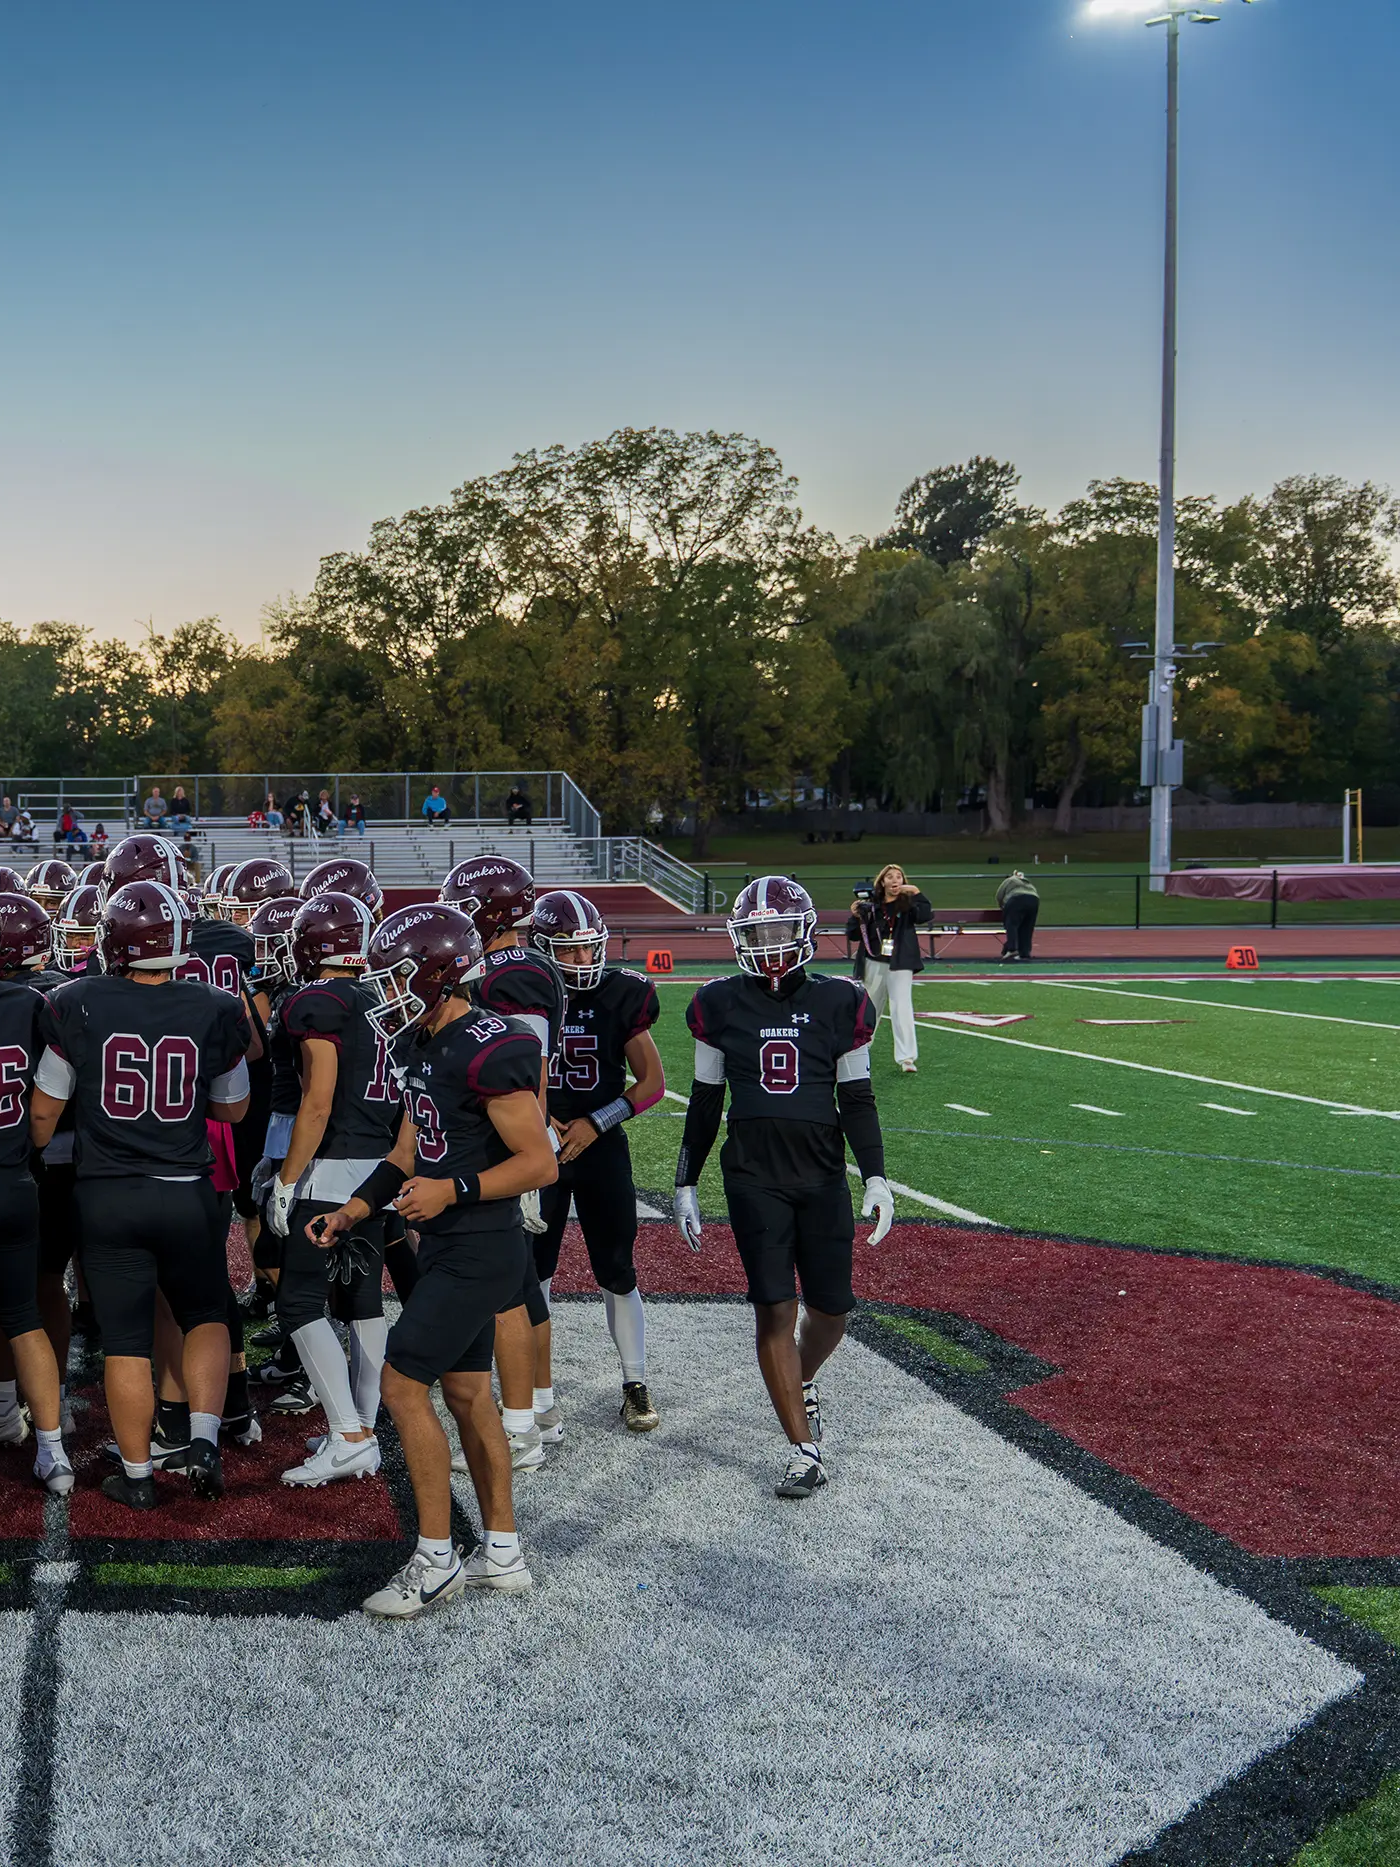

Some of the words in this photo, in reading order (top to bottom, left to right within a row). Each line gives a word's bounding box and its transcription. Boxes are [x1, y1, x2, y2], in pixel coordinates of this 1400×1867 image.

[310, 867, 349, 896] Quakers
[457, 865, 507, 887] Quakers
[159, 901, 191, 921] 60
[268, 908, 298, 923] Quak
[380, 911, 435, 949] Quakers
[575, 928, 596, 937] Riddell
[342, 956, 367, 965] Ridd
[490, 950, 526, 966] 50
[652, 953, 672, 970] 40
[1234, 949, 1256, 966] 30
[466, 1017, 507, 1043] 13
[562, 1026, 585, 1034] KERS
[759, 1028, 799, 1038] QUAKERS
[759, 1040, 799, 1094] 9
[100, 1032, 199, 1122] 60
